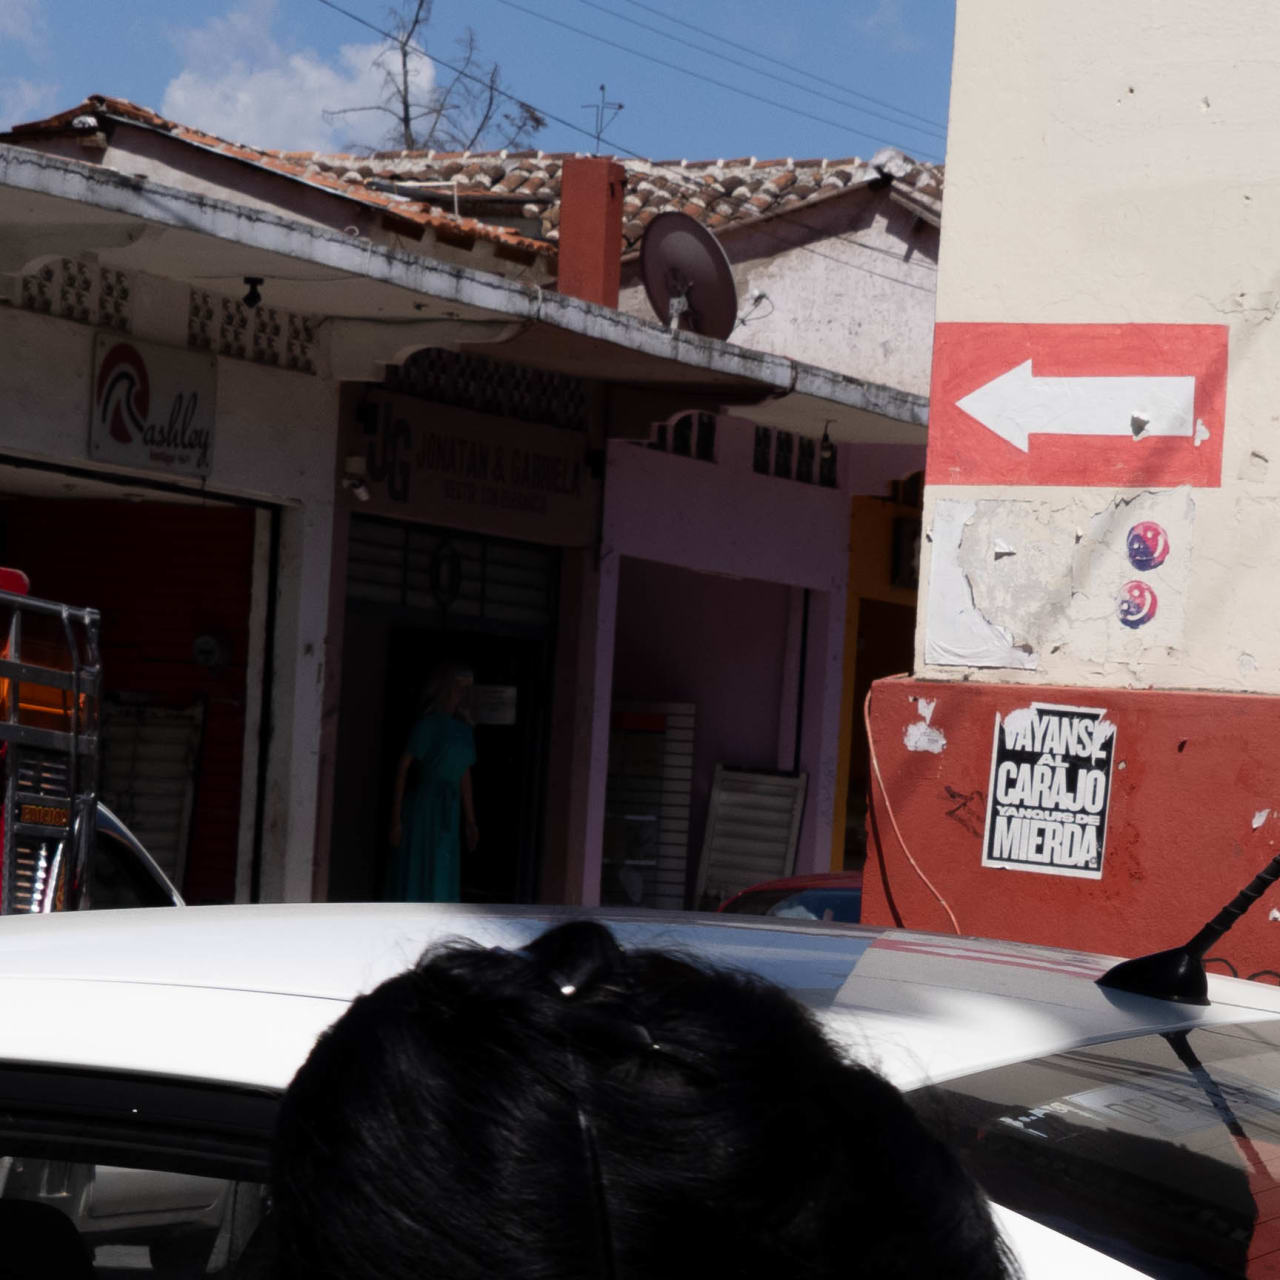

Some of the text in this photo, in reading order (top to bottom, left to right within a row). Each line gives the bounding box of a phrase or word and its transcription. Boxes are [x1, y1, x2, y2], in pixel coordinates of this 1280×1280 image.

[1003, 715, 1112, 758] VAYANSE
[1037, 754, 1069, 768] AL
[996, 761, 1106, 813] CARAJO
[996, 806, 1101, 825] YANQUIS DE
[993, 816, 1098, 868] MIERDA
